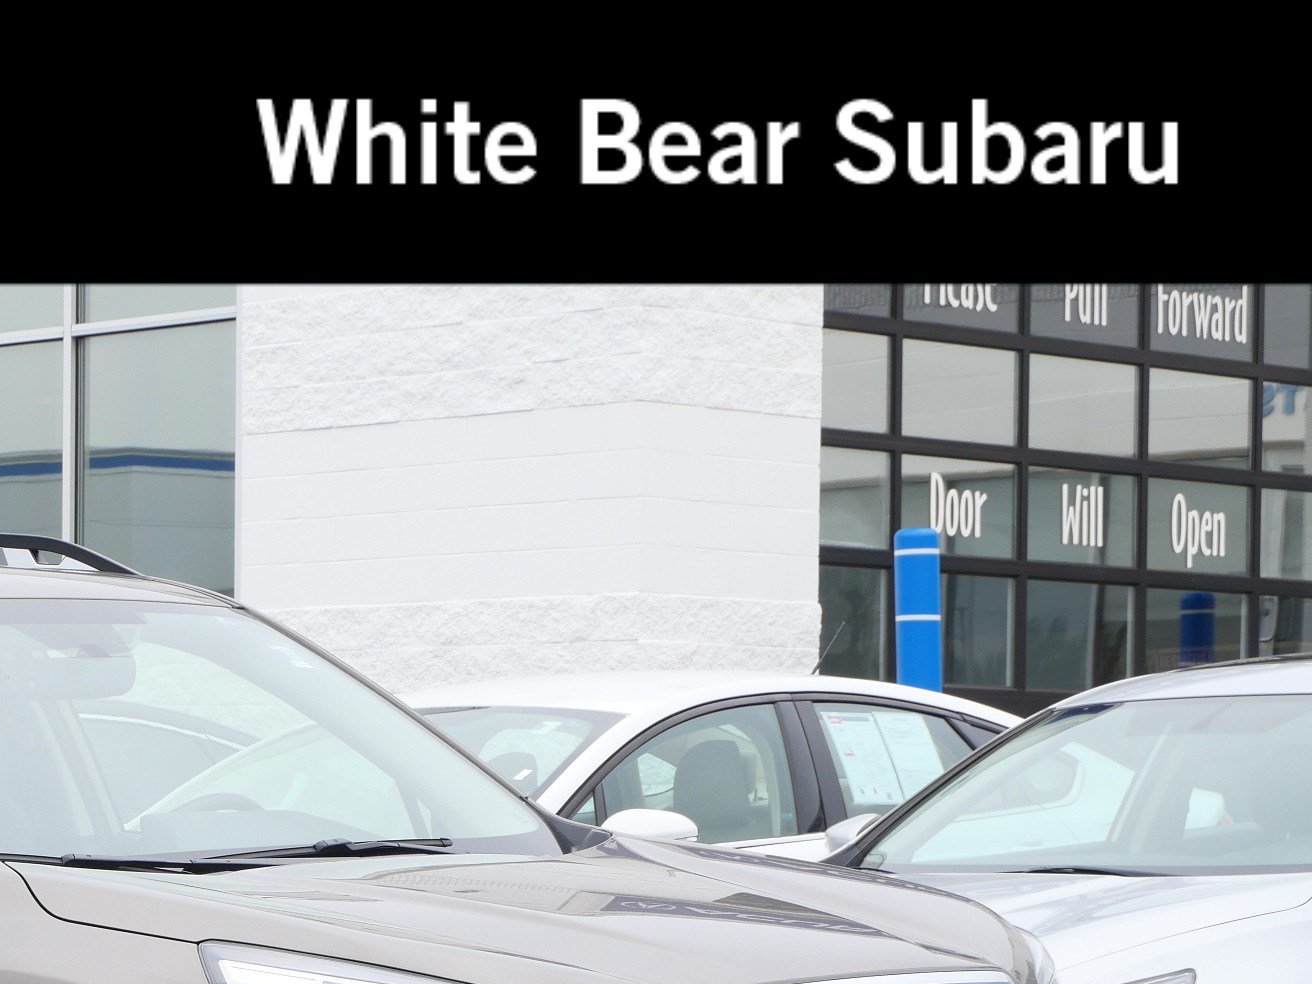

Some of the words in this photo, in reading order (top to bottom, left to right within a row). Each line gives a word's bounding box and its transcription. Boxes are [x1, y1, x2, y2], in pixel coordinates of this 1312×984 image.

[1157, 285, 1248, 344] Forward
[930, 472, 987, 538] Door
[1062, 483, 1104, 547] Will
[1171, 493, 1226, 568] Open
